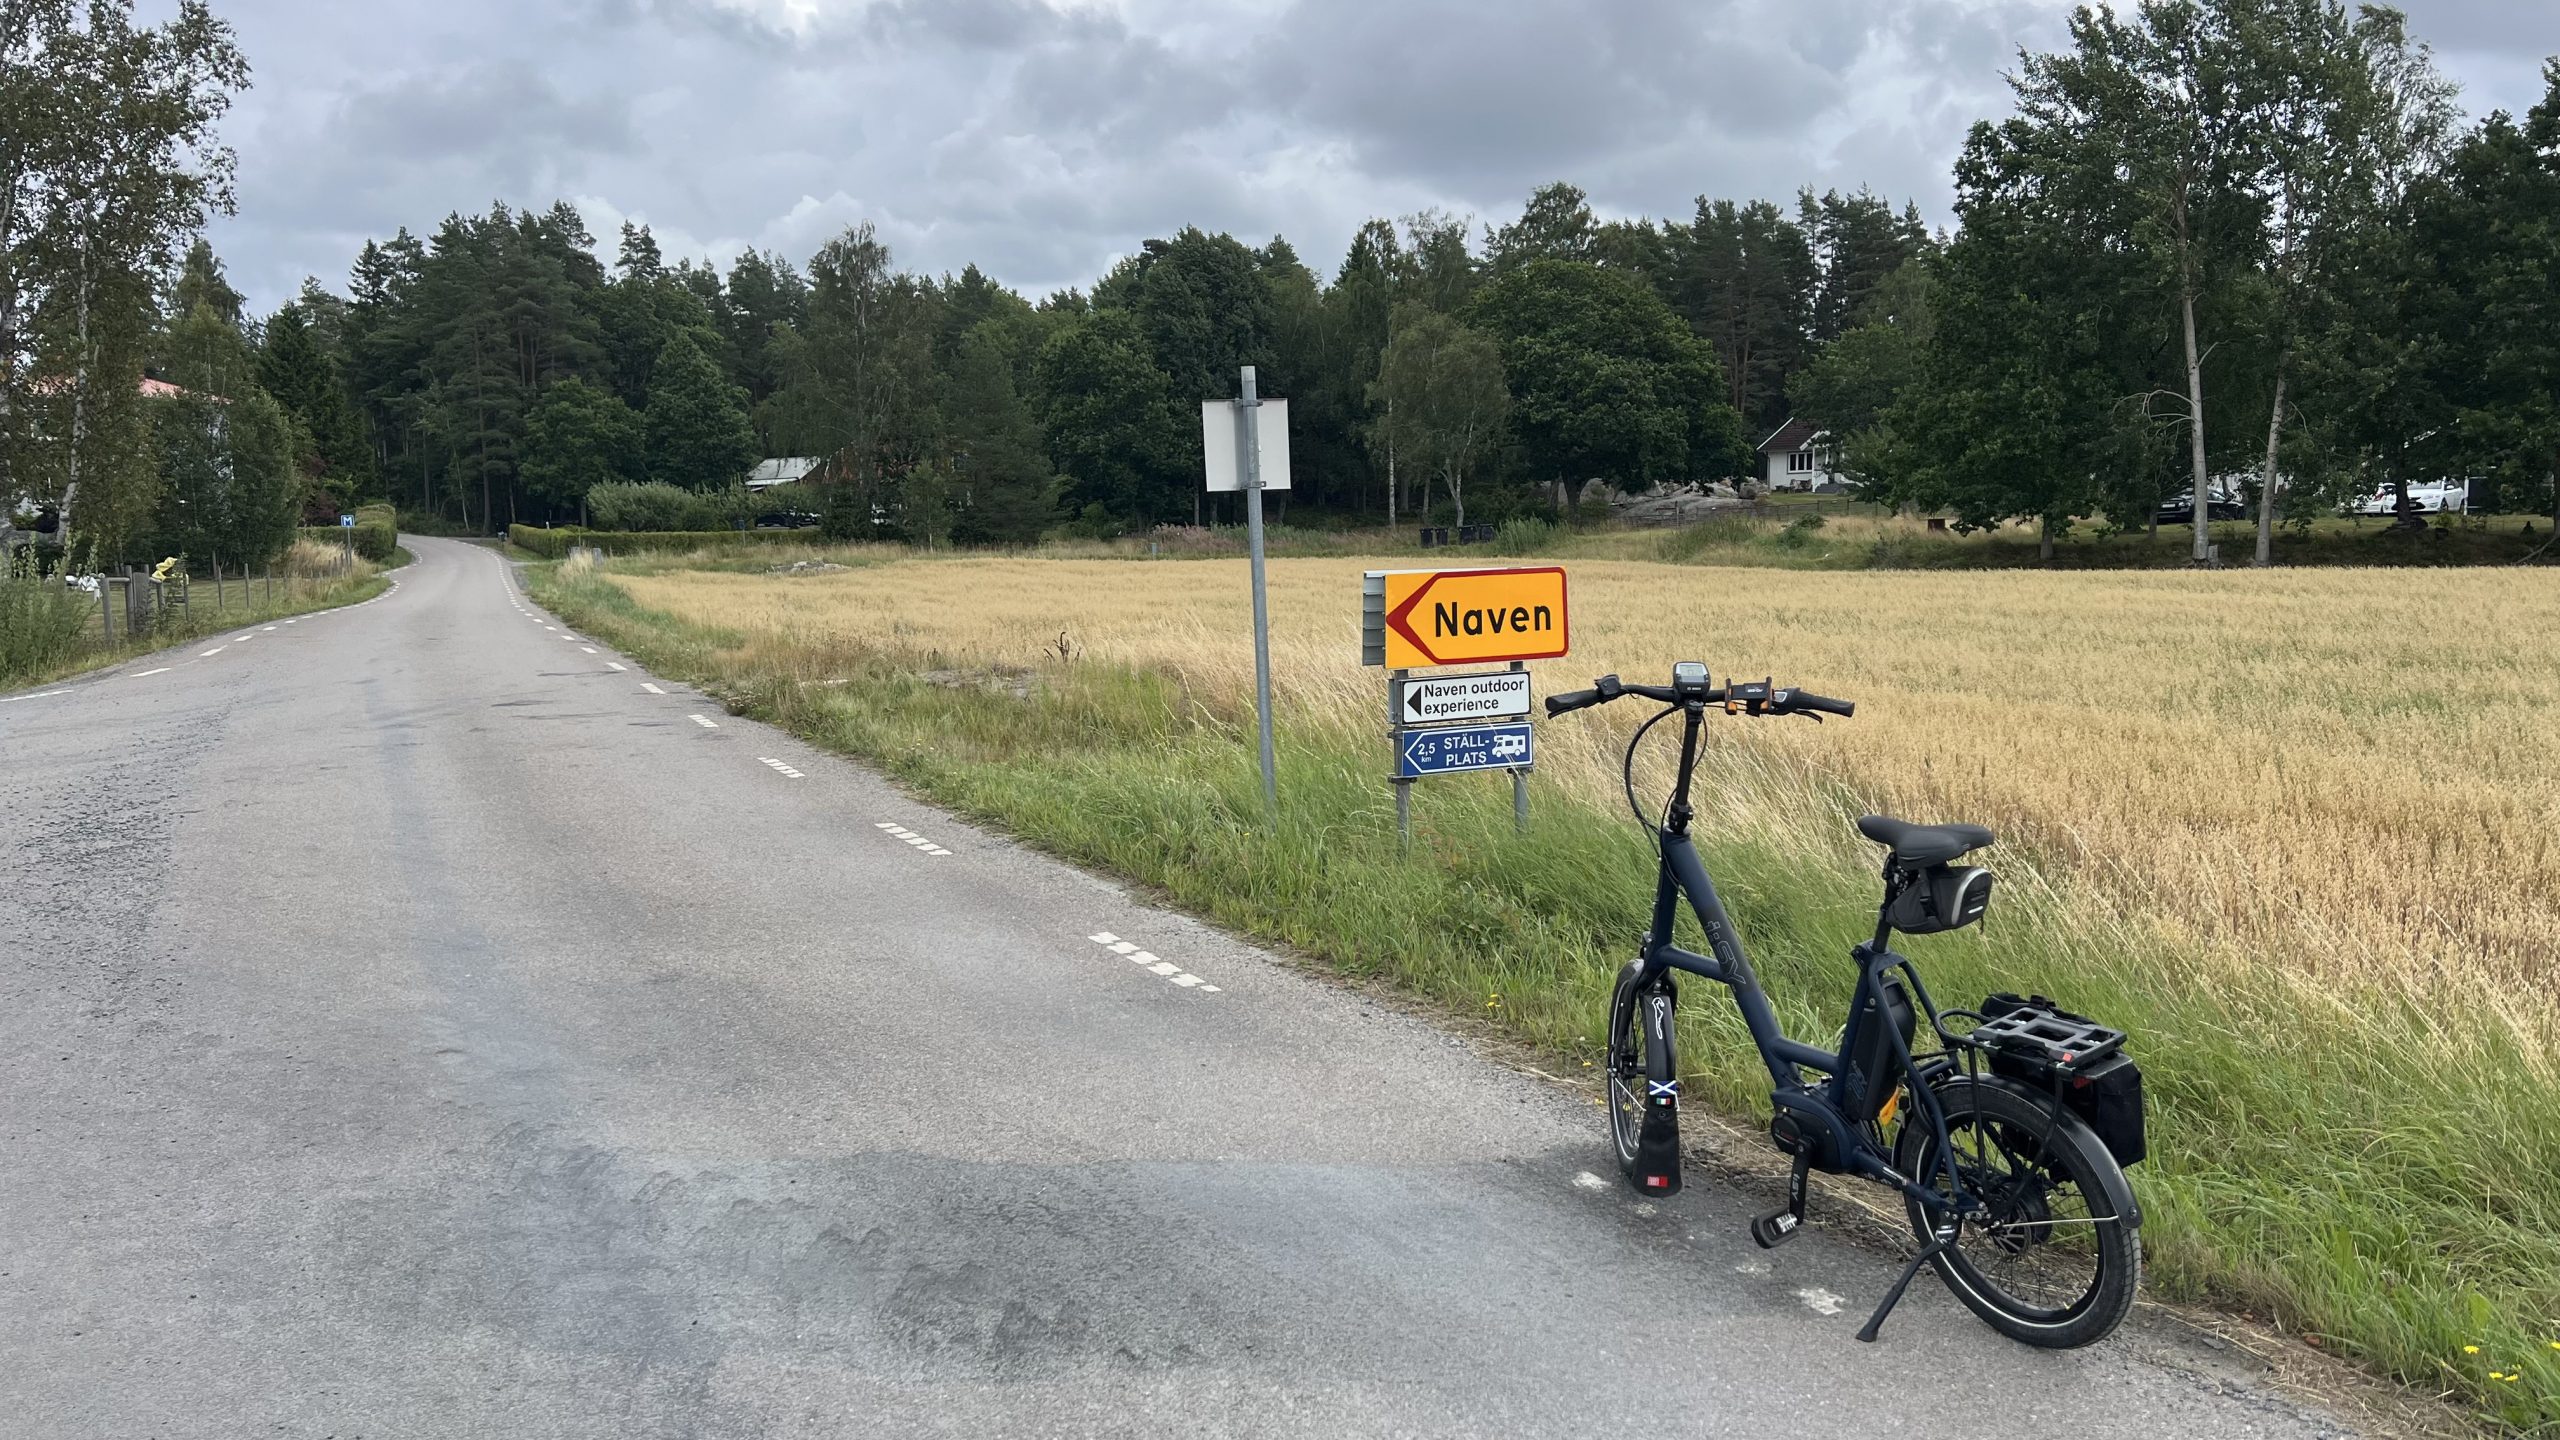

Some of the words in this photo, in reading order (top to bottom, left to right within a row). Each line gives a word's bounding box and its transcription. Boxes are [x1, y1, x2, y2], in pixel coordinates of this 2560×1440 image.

[1435, 602, 1551, 637] Naven
[1424, 684, 1467, 698] Naven
[1471, 679, 1525, 694] outdoor
[1424, 698, 1499, 718] experience
[1417, 742, 1436, 756] 2,5
[1443, 733, 1490, 750] STÄLL-
[1421, 755, 1432, 763] km
[1445, 751, 1487, 766] PLATS
